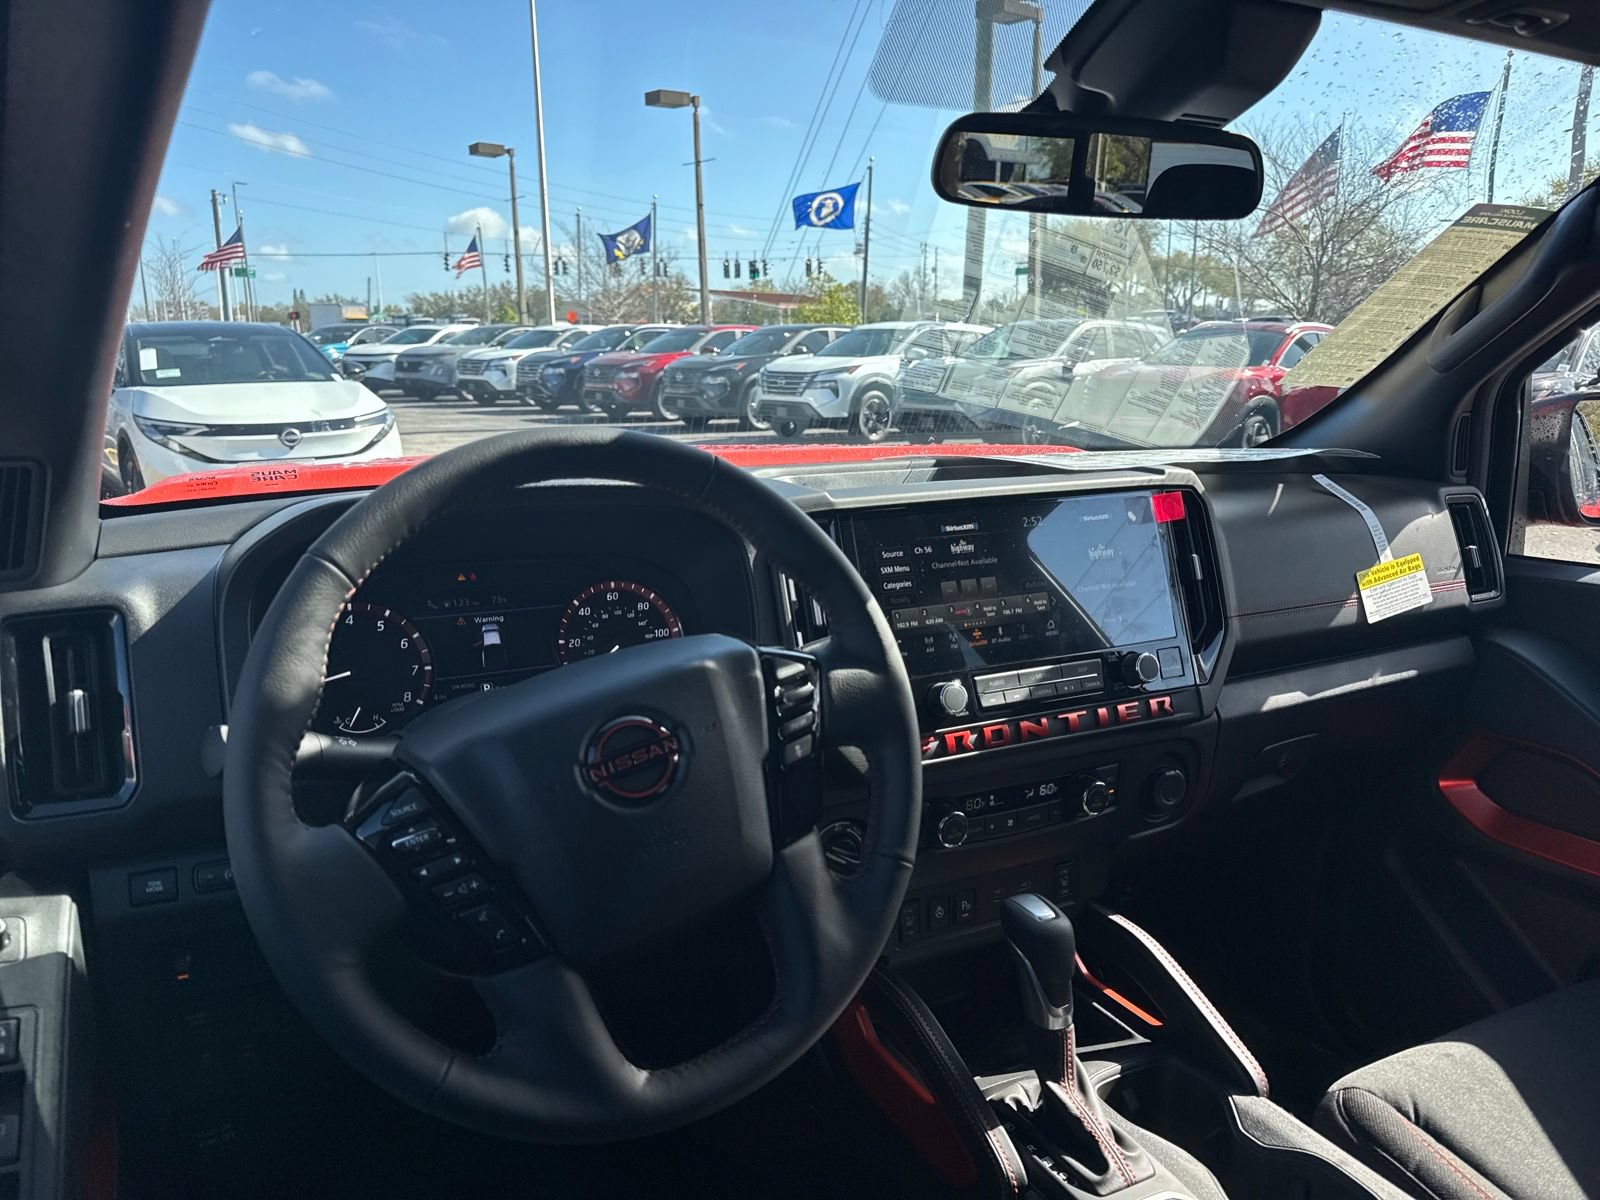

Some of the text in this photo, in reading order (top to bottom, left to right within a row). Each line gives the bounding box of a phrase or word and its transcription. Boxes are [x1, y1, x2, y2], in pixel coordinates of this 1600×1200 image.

[881, 550, 905, 559] Source
[914, 545, 933, 555] Ch 56
[971, 555, 998, 567] Available
[1371, 566, 1389, 575] Vehicle
[1396, 555, 1420, 568] Equipped
[880, 564, 911, 575] SXM Menu
[1373, 571, 1398, 582] Advanced
[1408, 563, 1421, 571] Bags
[883, 580, 912, 591] Categories
[606, 591, 619, 601] 60
[578, 606, 591, 616] 40
[637, 601, 650, 611] 80
[345, 614, 354, 626] 4
[473, 615, 505, 625] Warning
[376, 620, 385, 632] 5
[654, 628, 670, 638] 100
[400, 638, 409, 650] 6
[568, 638, 581, 648] 20
[411, 664, 419, 676] 7
[403, 691, 412, 703] 8
[372, 713, 379, 721] H
[590, 737, 679, 783] NISSAN
[389, 802, 418, 817] SOURCE
[404, 833, 430, 848] ENTER
